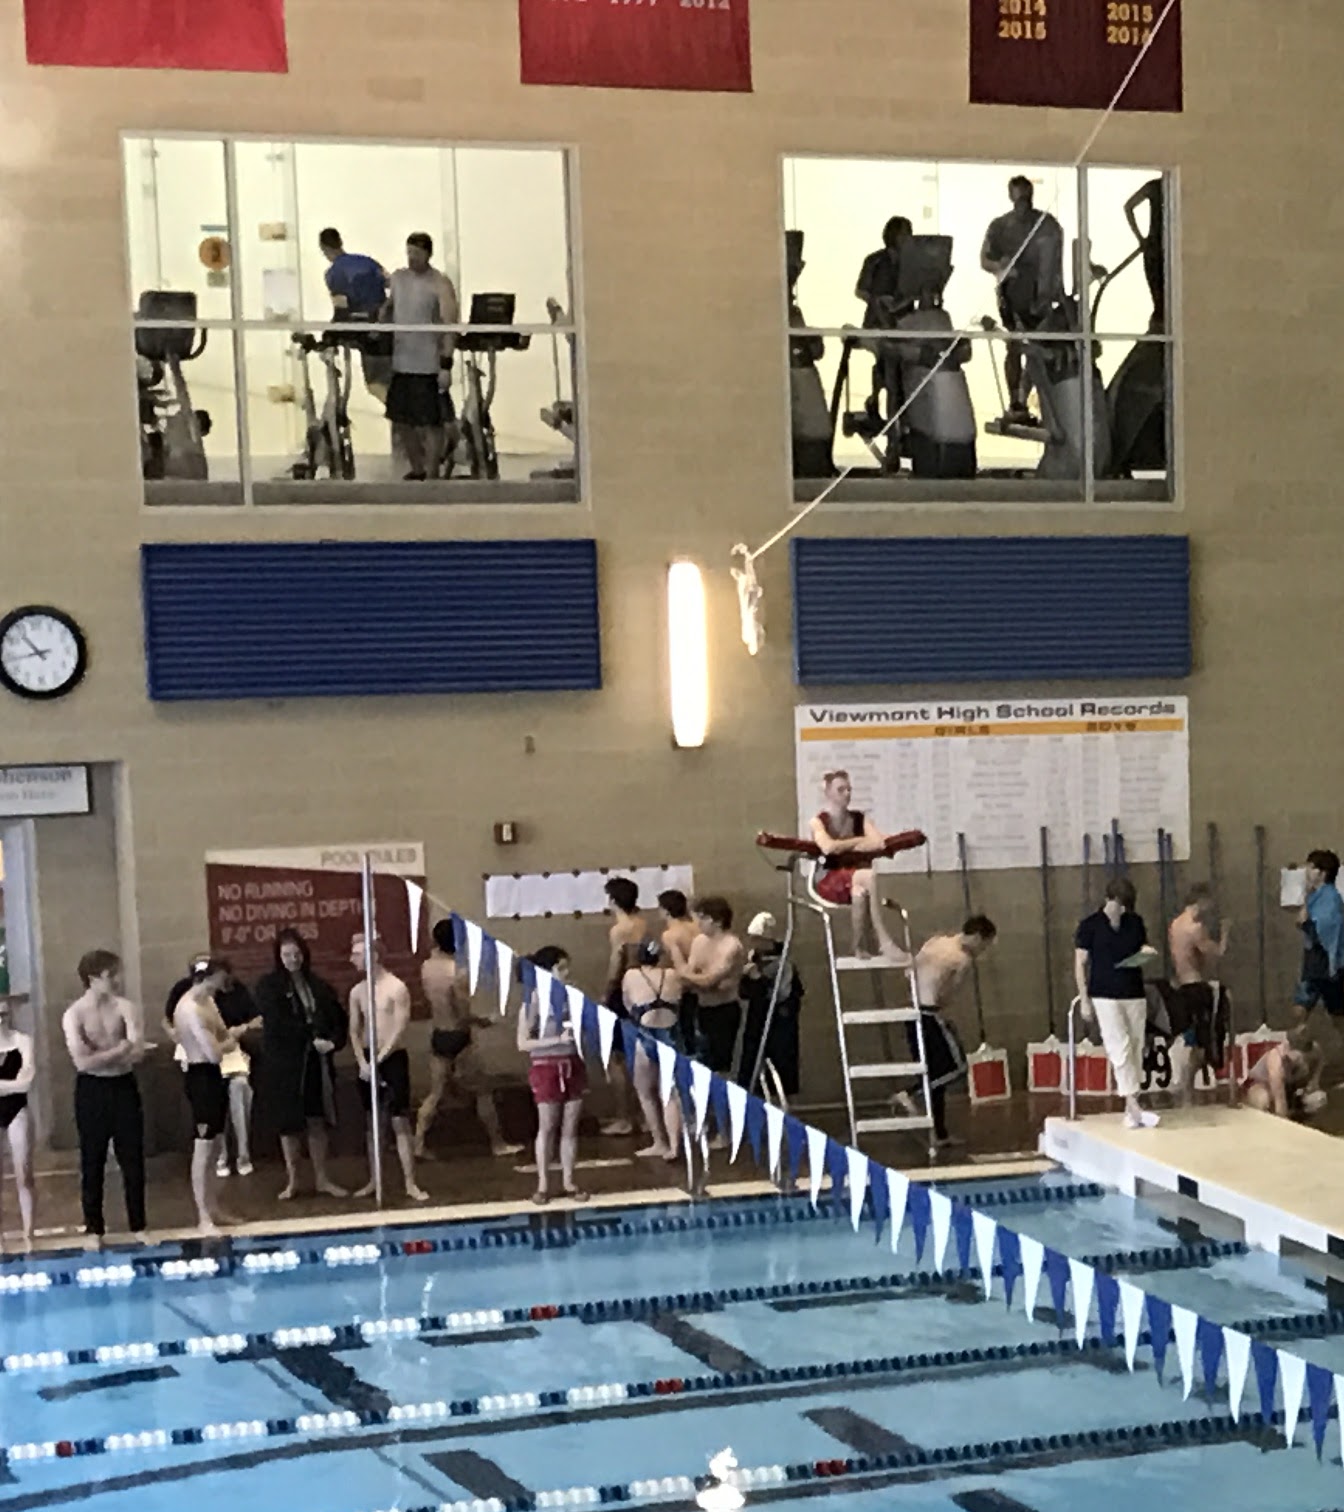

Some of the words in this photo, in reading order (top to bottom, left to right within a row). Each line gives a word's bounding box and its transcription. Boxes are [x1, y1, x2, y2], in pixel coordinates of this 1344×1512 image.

[810, 707, 931, 723] Viewmont
[937, 704, 990, 722] High
[996, 703, 1074, 719] School
[1080, 701, 1176, 717] Records
[218, 883, 241, 900] NO
[244, 880, 314, 899] RUNNING
[219, 905, 242, 922] NO
[246, 901, 297, 920] DIVING
[300, 901, 315, 918] IN
